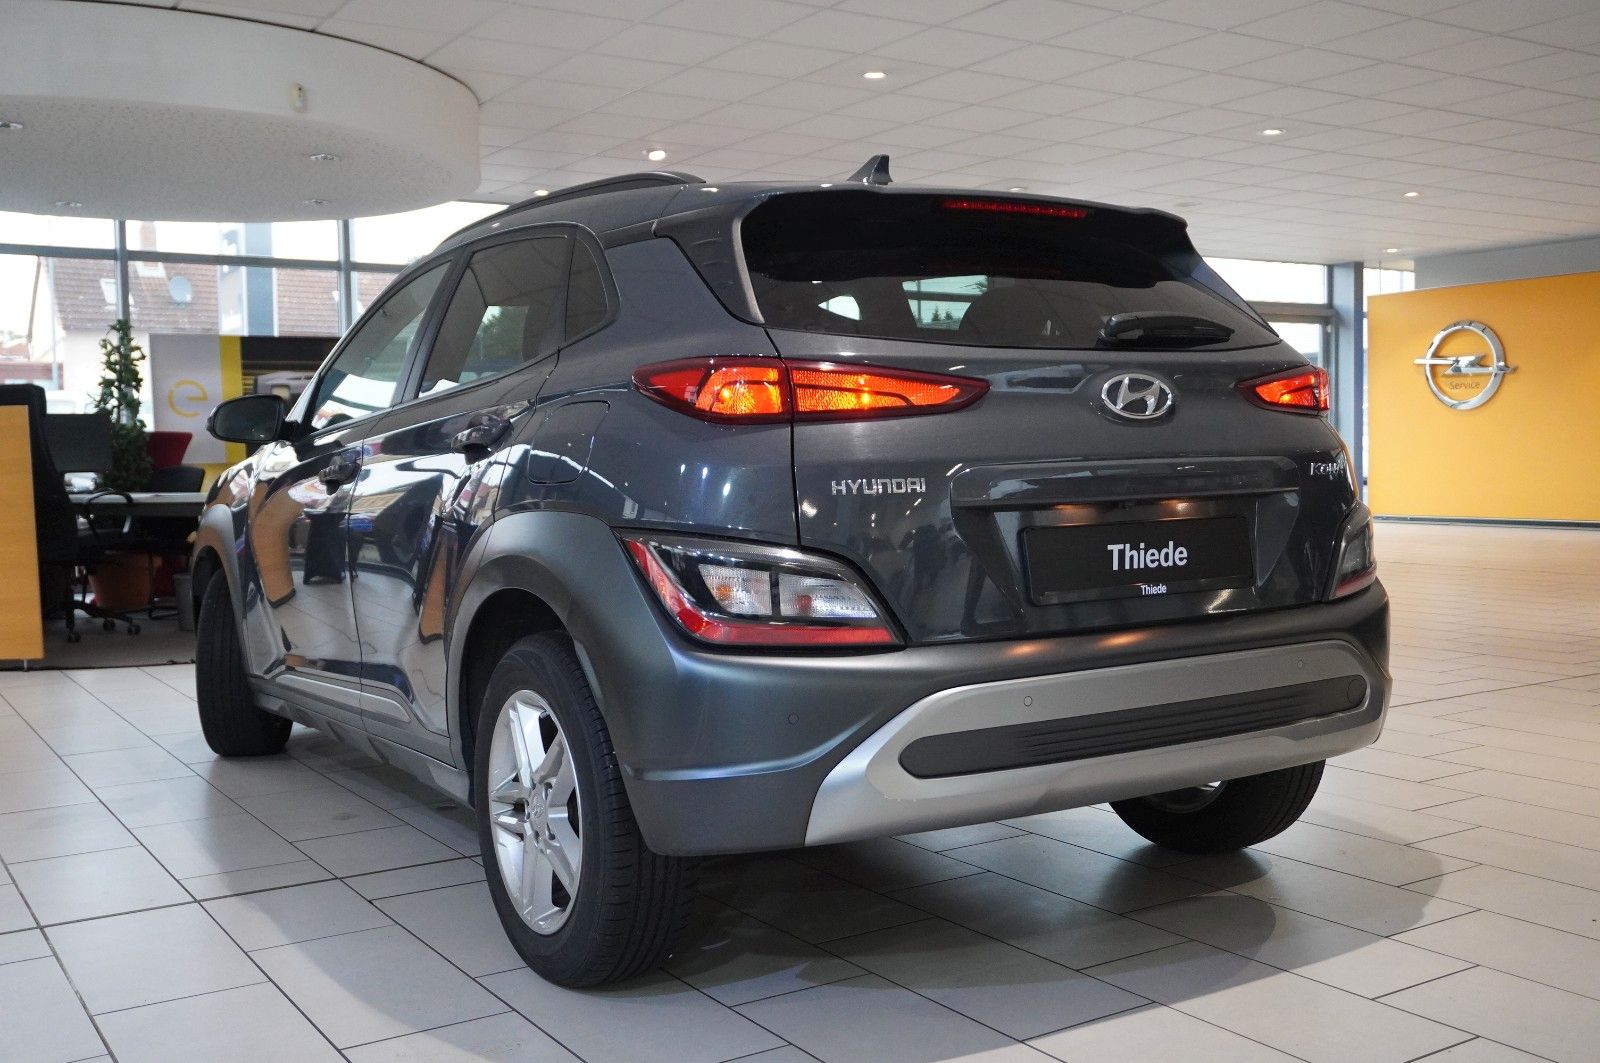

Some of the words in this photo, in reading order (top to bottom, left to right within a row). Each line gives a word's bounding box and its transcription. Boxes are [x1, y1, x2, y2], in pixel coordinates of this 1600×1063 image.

[1449, 381, 1480, 390] Service
[831, 478, 926, 496] HYUNDAI
[1107, 541, 1188, 571] Thiede
[1140, 584, 1167, 596] Thiede
